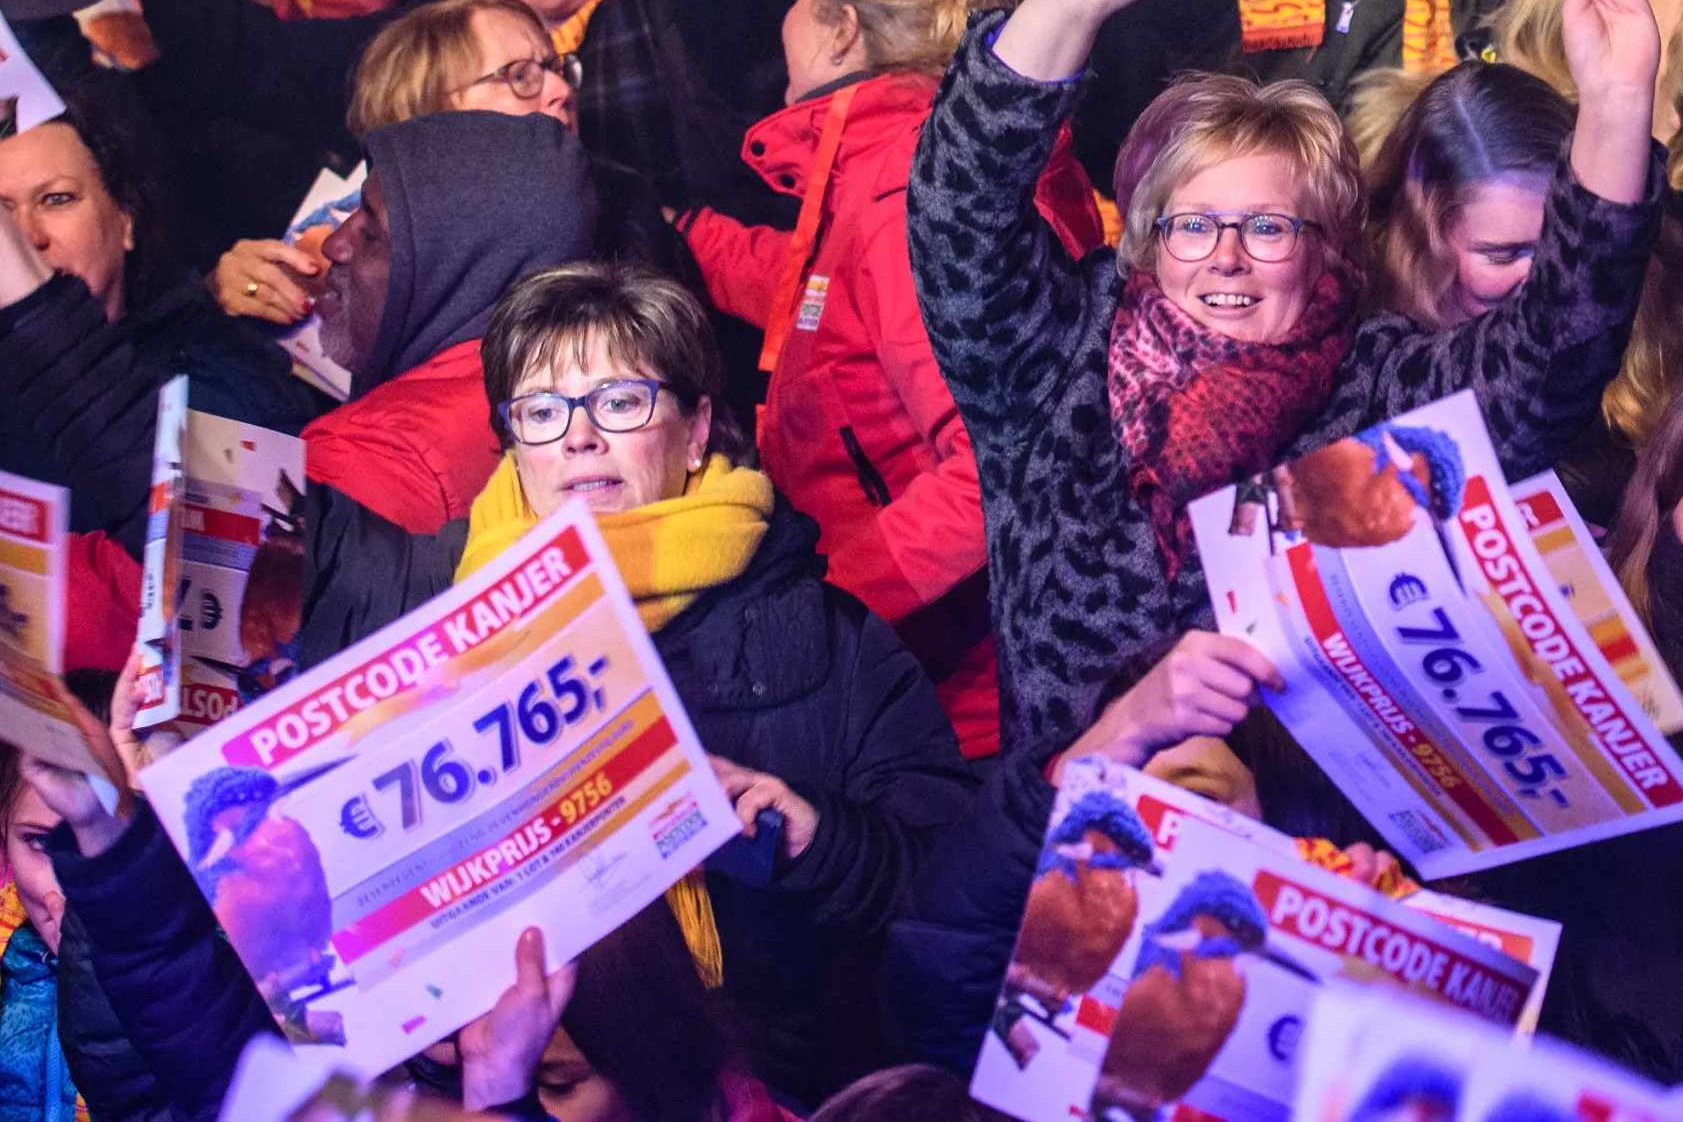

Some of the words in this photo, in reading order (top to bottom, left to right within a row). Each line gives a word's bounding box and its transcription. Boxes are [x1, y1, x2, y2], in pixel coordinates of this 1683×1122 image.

[1389, 572, 1428, 611] €
[250, 634, 448, 769] POSTCODE
[445, 547, 573, 653] KANJER
[1318, 632, 1415, 738] WIJKPRIJS
[1459, 506, 1582, 686] POSTCODE
[1566, 679, 1670, 791] KANJER
[338, 795, 383, 840] €
[420, 822, 553, 910] WIJKPRIJS
[558, 775, 614, 825] 9756
[1271, 883, 1448, 988] POSTCODE
